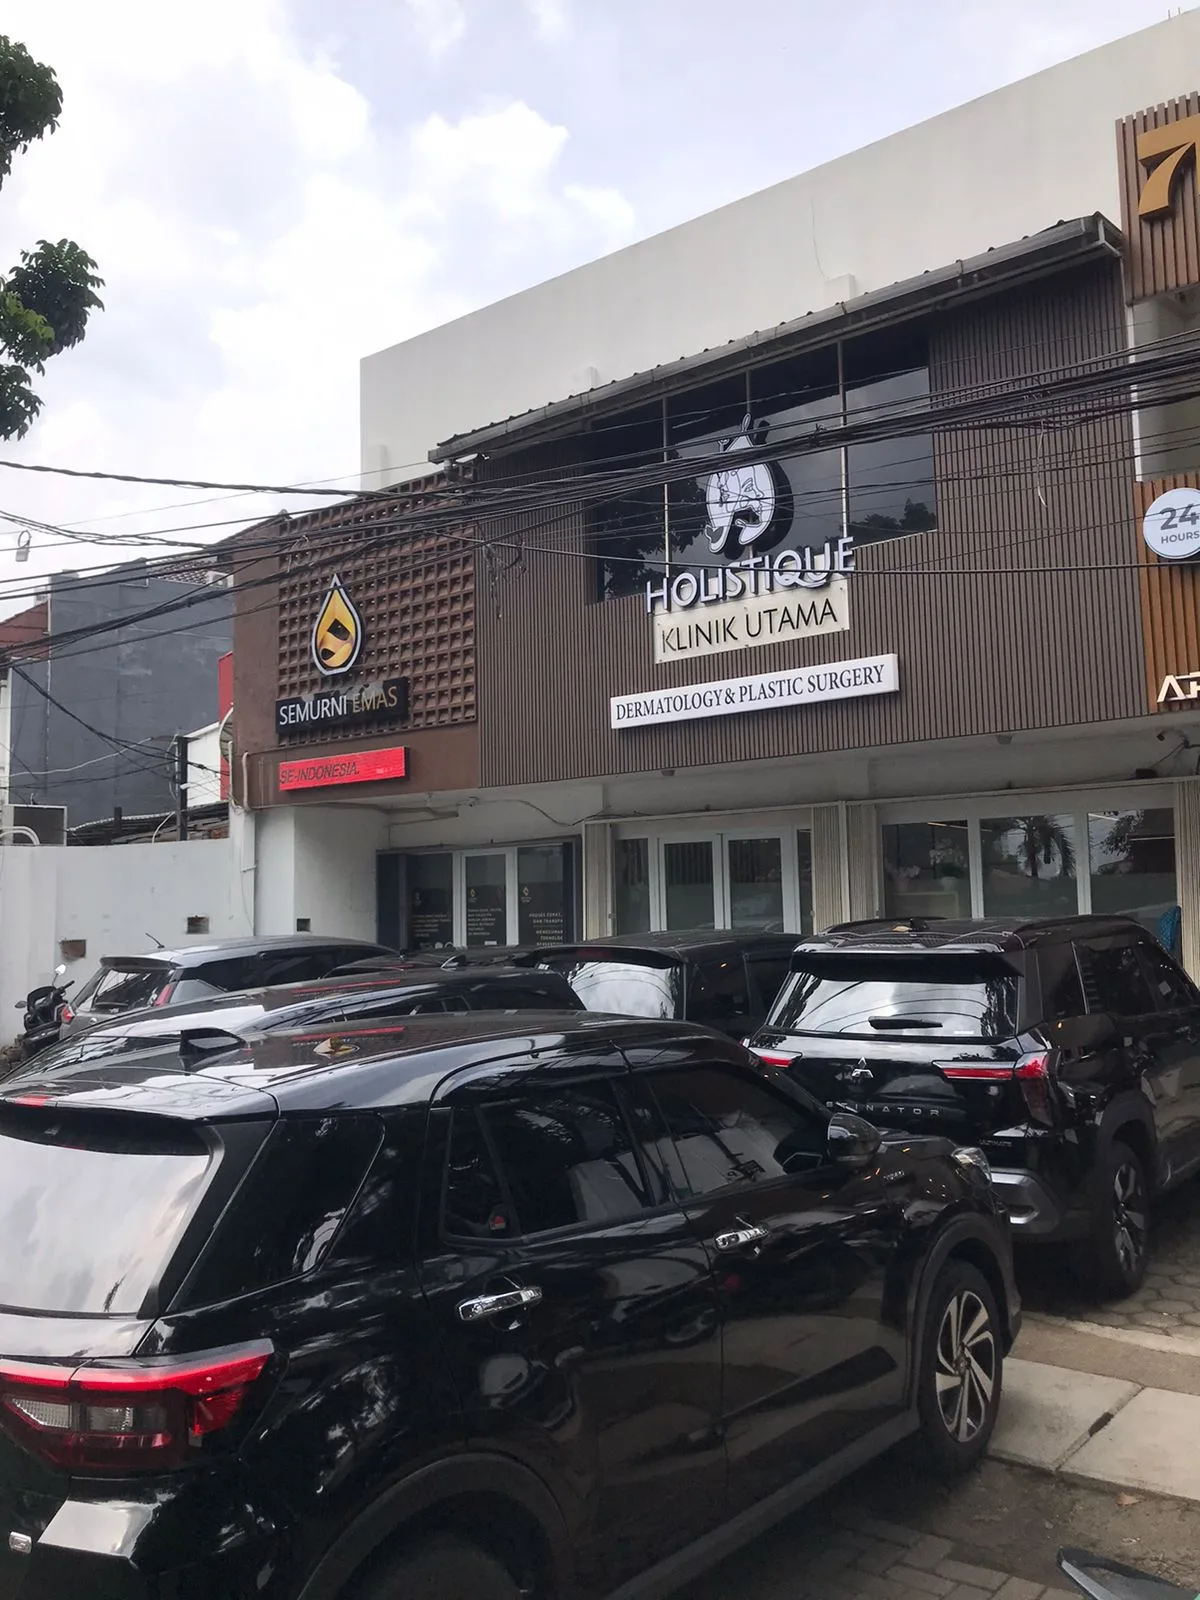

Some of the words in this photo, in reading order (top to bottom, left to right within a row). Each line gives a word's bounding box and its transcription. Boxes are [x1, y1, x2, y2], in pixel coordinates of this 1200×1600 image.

[1160, 503, 1199, 531] 24
[1161, 530, 1200, 544] HOURS
[646, 536, 856, 616] HOLISTIQUE
[661, 616, 738, 654] KLINIK
[745, 598, 838, 638] UTAMA
[739, 676, 803, 703] PLASTIC
[807, 664, 885, 694] SURGERY
[279, 694, 347, 726] SEMURNI
[352, 686, 398, 714] EMAS
